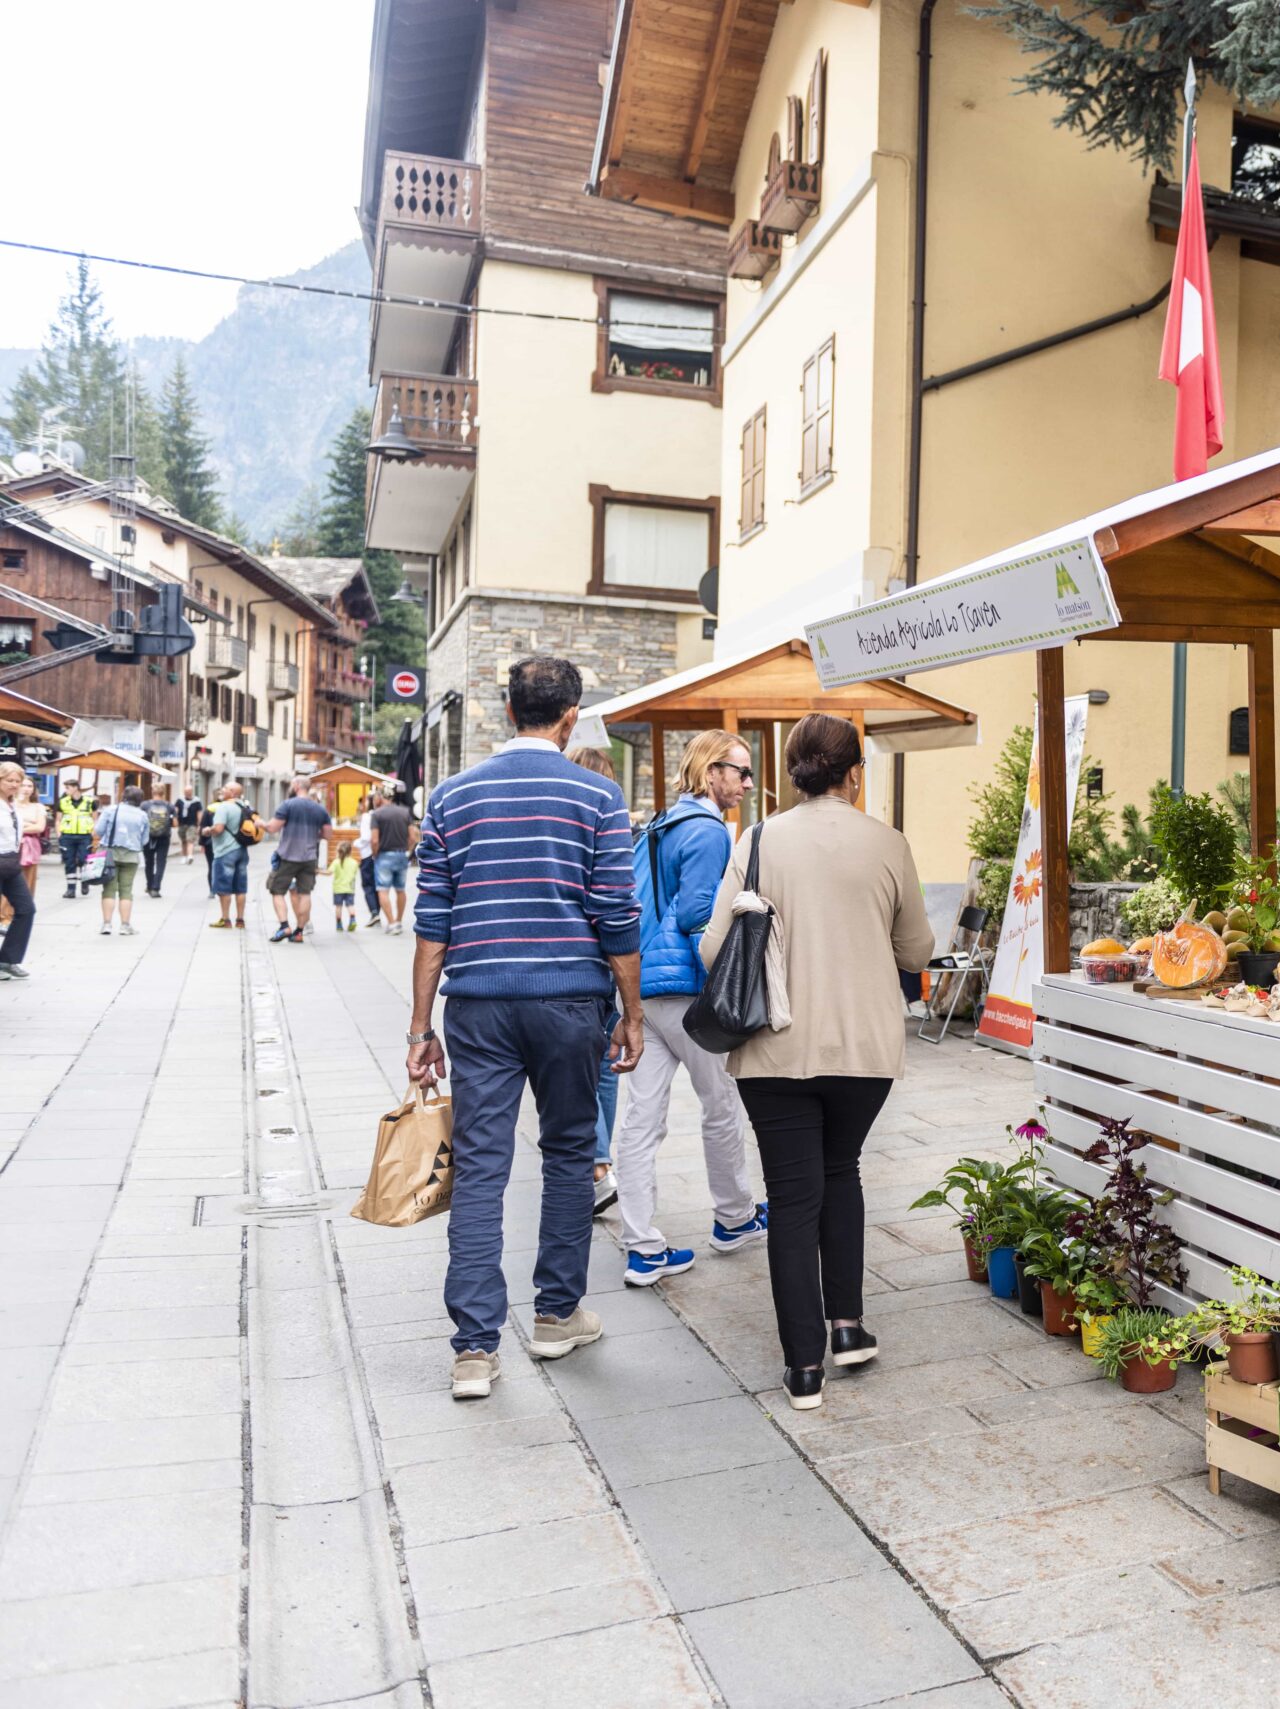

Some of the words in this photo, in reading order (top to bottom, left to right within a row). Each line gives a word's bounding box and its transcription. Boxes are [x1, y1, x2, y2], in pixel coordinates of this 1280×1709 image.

[857, 623, 899, 655] Azienda
[897, 609, 945, 650] Agricola
[942, 608, 959, 633] Lo
[958, 601, 1002, 633] Tsaven
